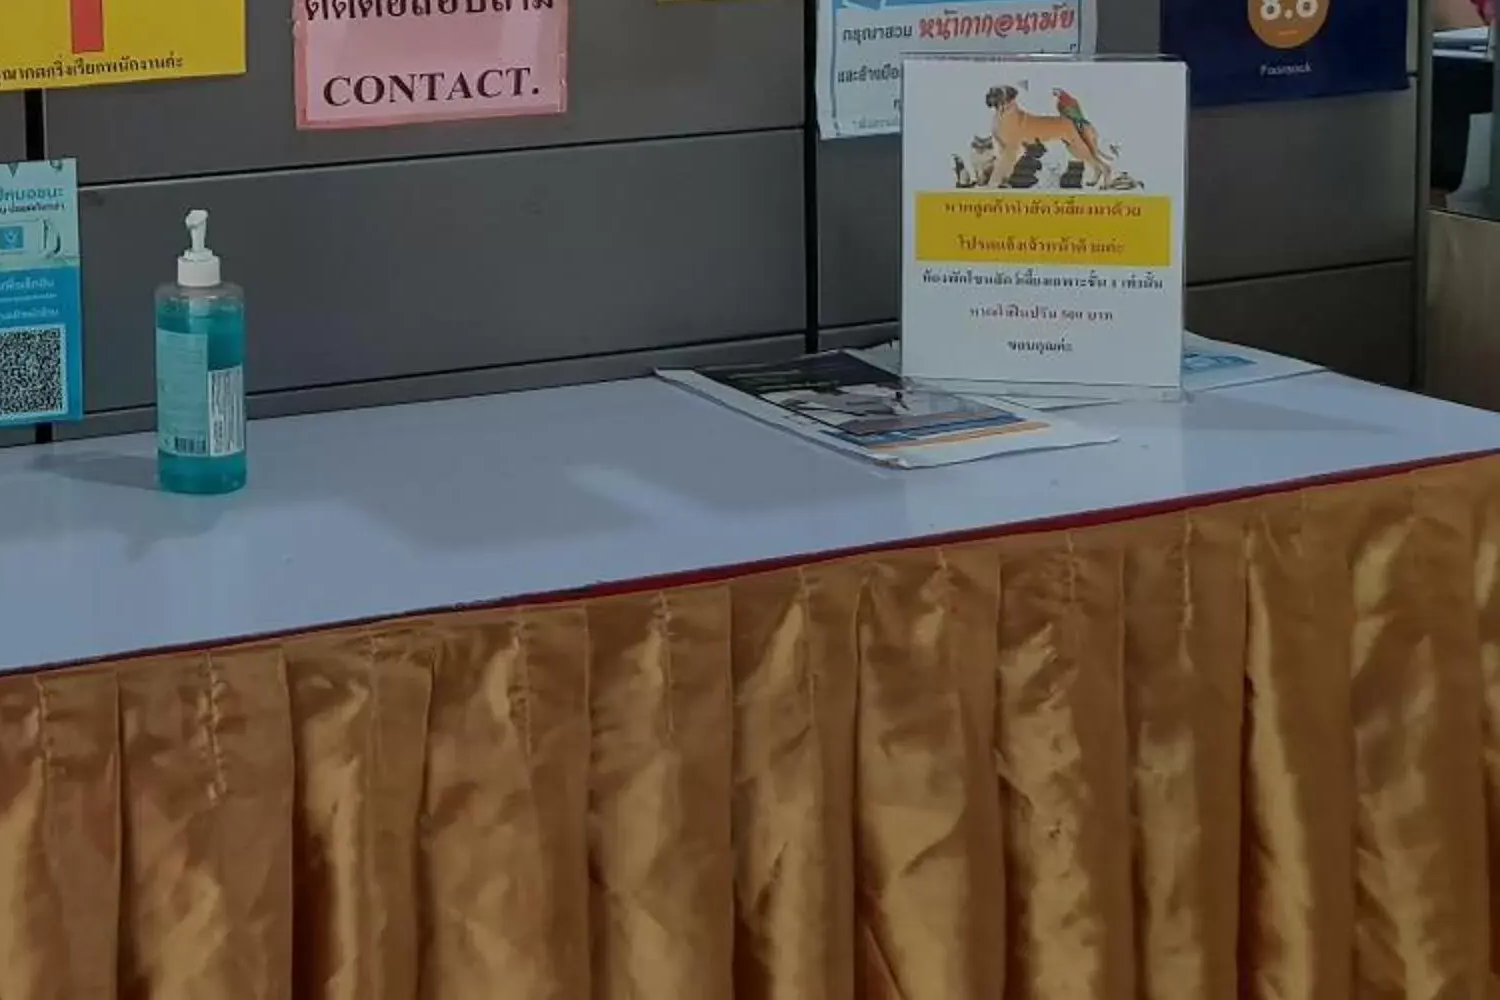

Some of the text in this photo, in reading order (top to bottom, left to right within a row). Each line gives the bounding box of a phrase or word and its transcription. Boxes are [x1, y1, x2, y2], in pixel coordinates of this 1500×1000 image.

[918, 2, 1075, 41] หน้ากากอนามัย
[323, 65, 540, 107] CONTACT.
